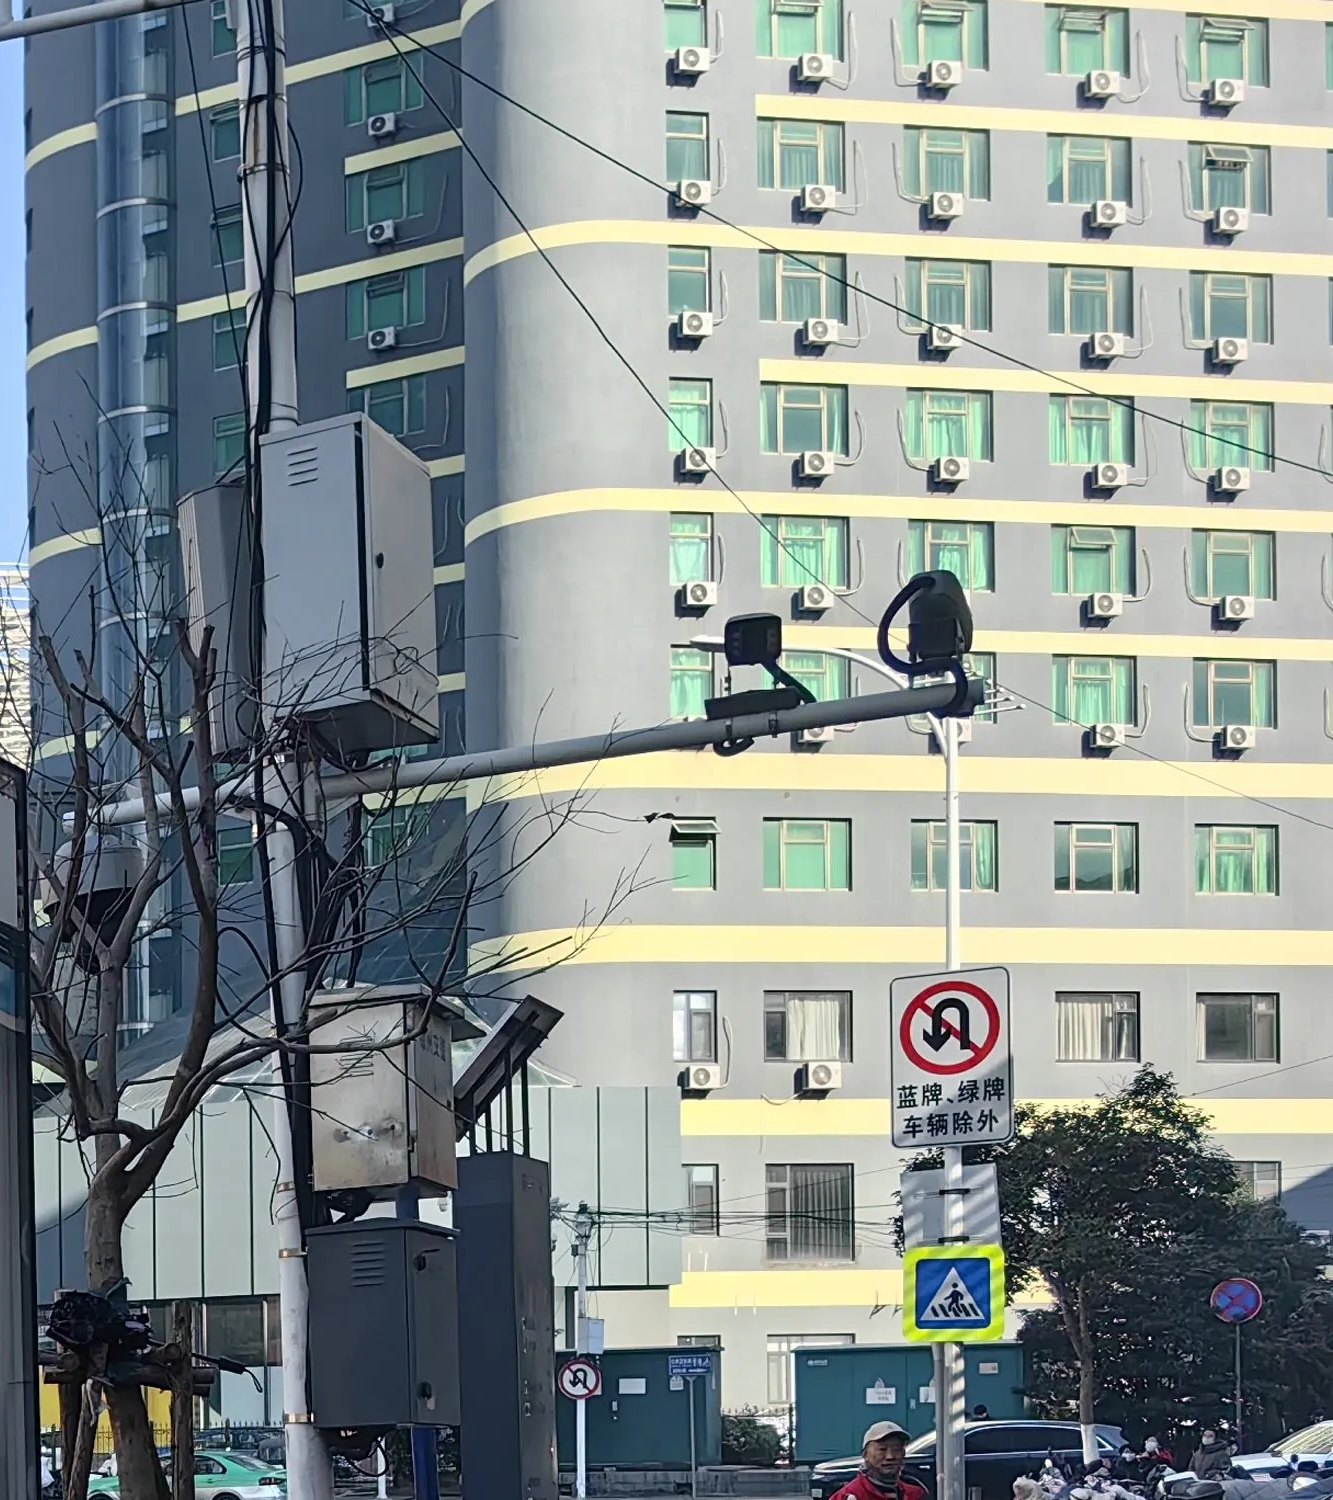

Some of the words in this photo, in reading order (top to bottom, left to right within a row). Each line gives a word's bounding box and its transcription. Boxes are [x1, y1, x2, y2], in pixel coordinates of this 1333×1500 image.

[896, 1077, 1006, 1109] 蓝牌、绿牌
[902, 1108, 1000, 1139] 车辆除外
